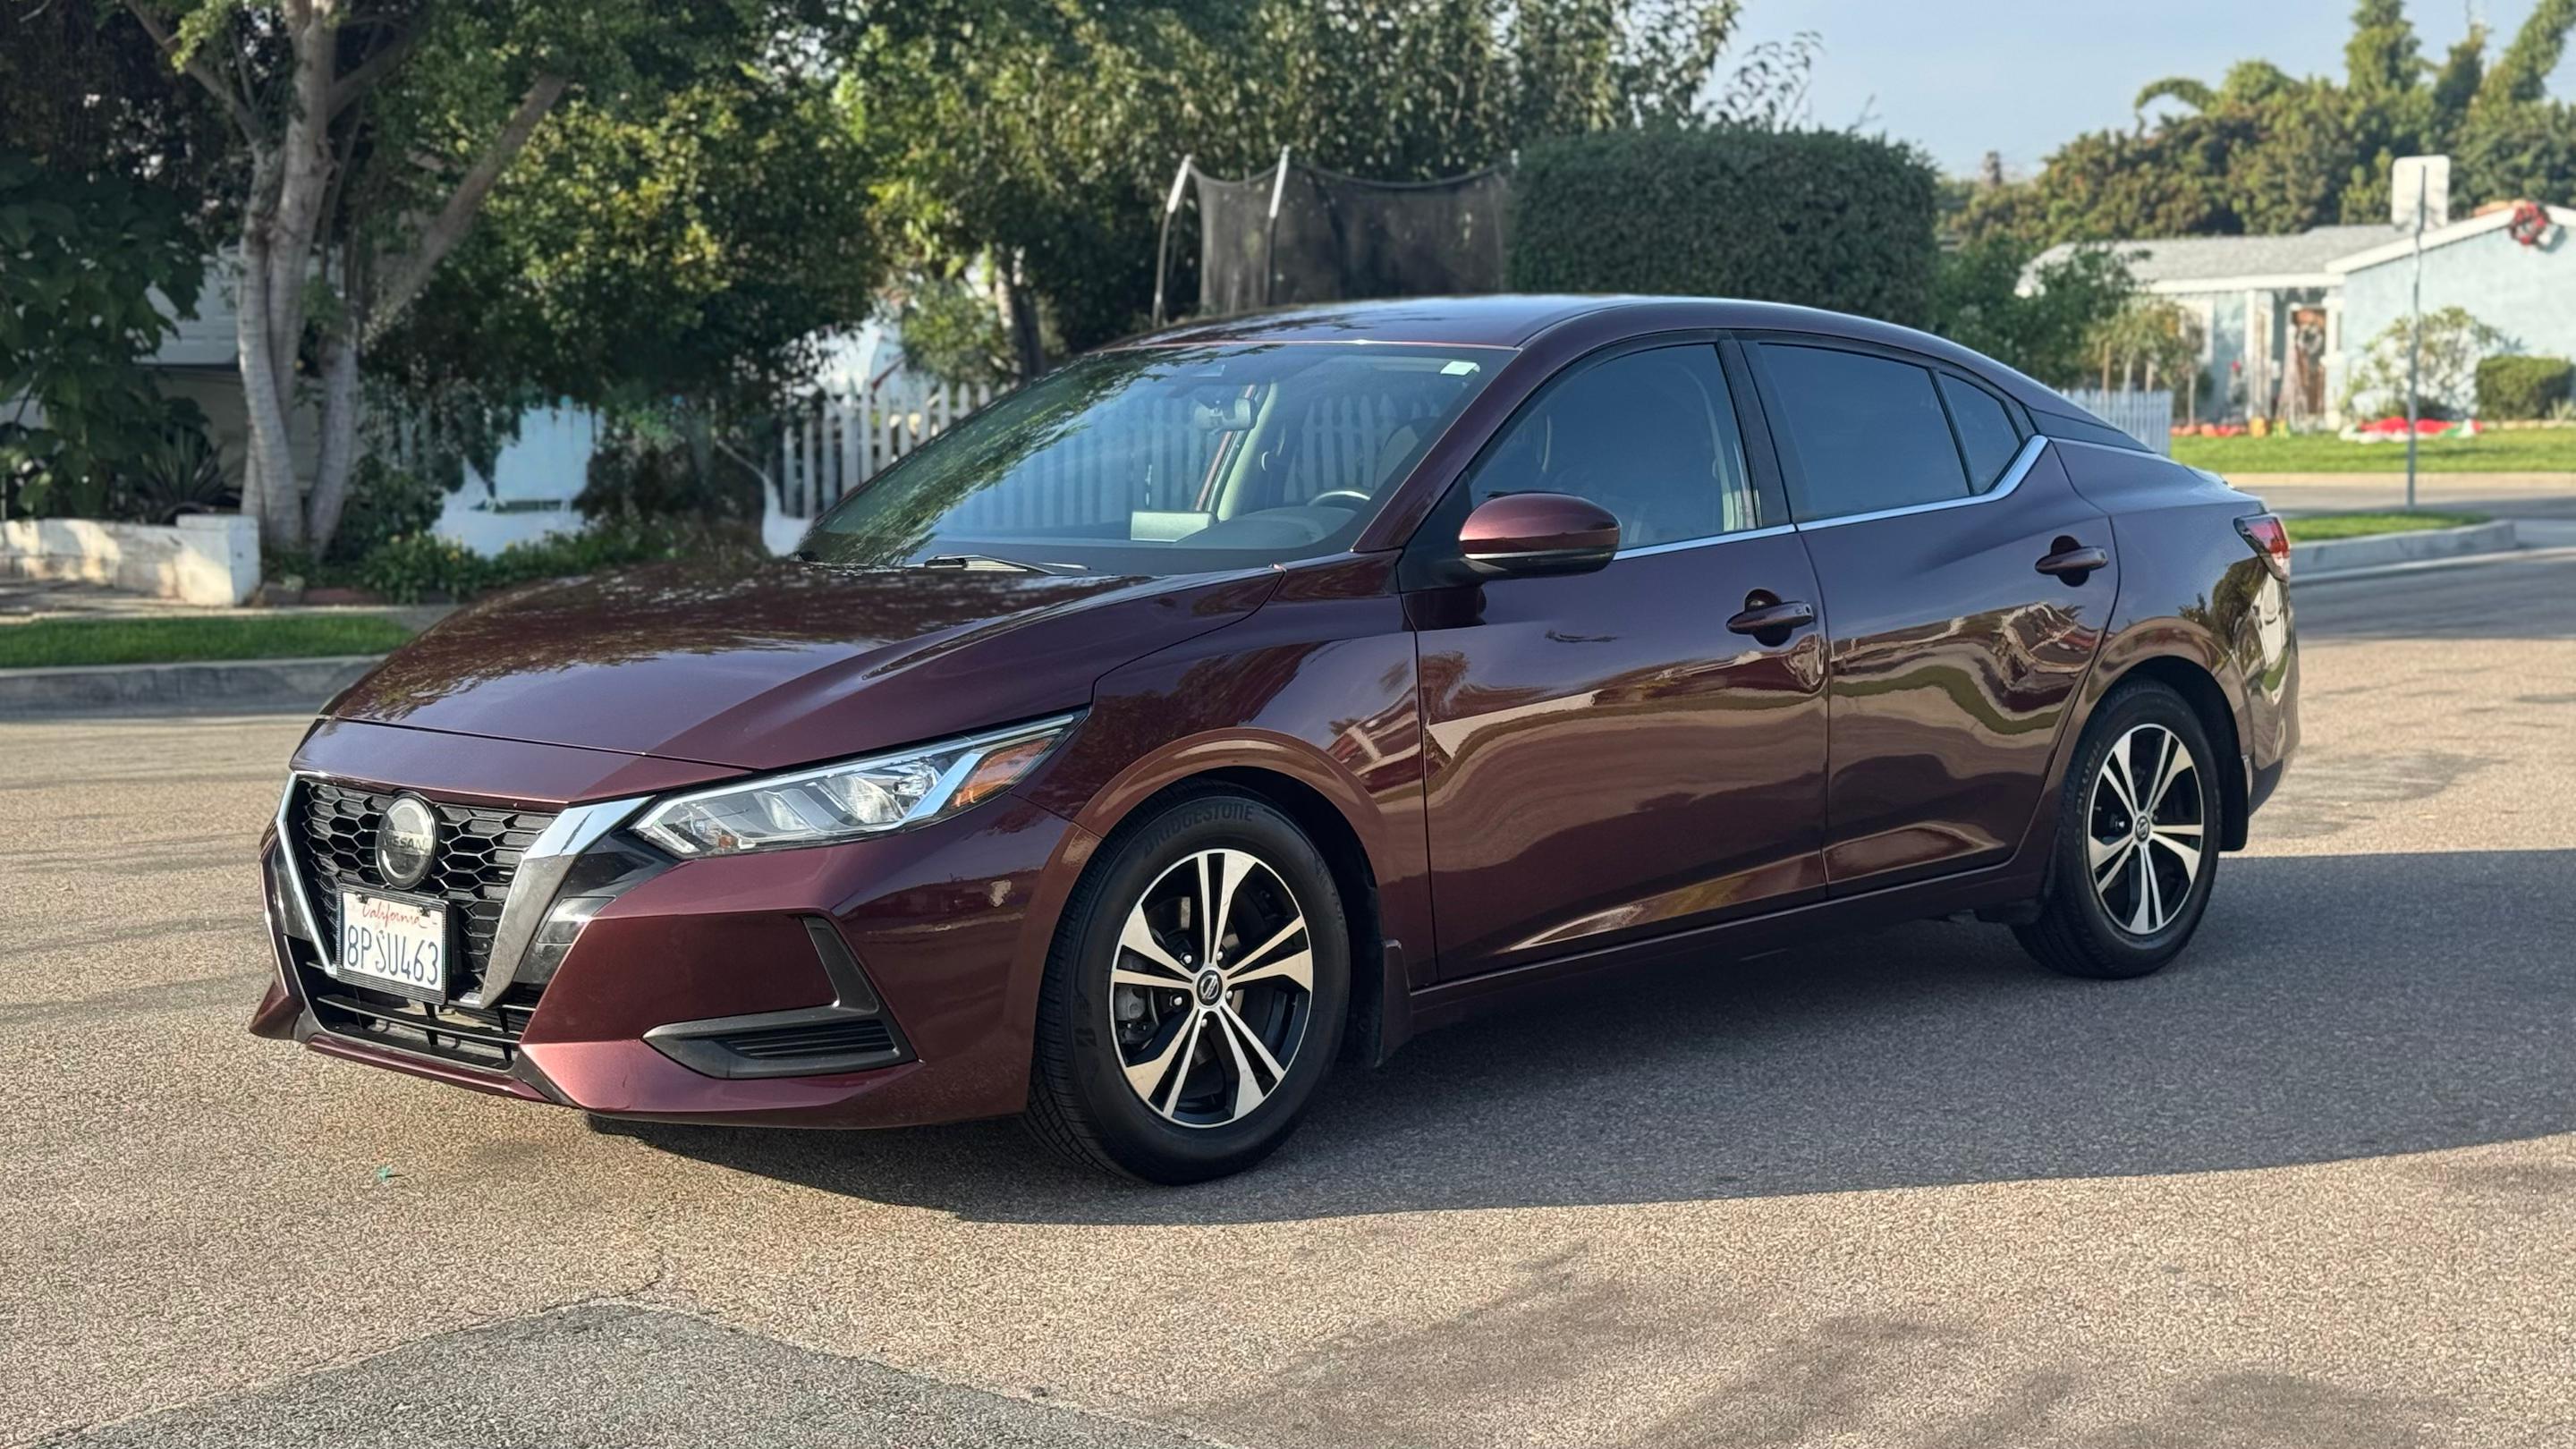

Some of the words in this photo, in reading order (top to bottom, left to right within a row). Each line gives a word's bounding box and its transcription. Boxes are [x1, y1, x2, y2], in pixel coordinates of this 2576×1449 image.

[1144, 803, 1255, 858] BRIDGESTONE
[362, 901, 419, 928] California
[347, 925, 438, 986] 8PSU463
